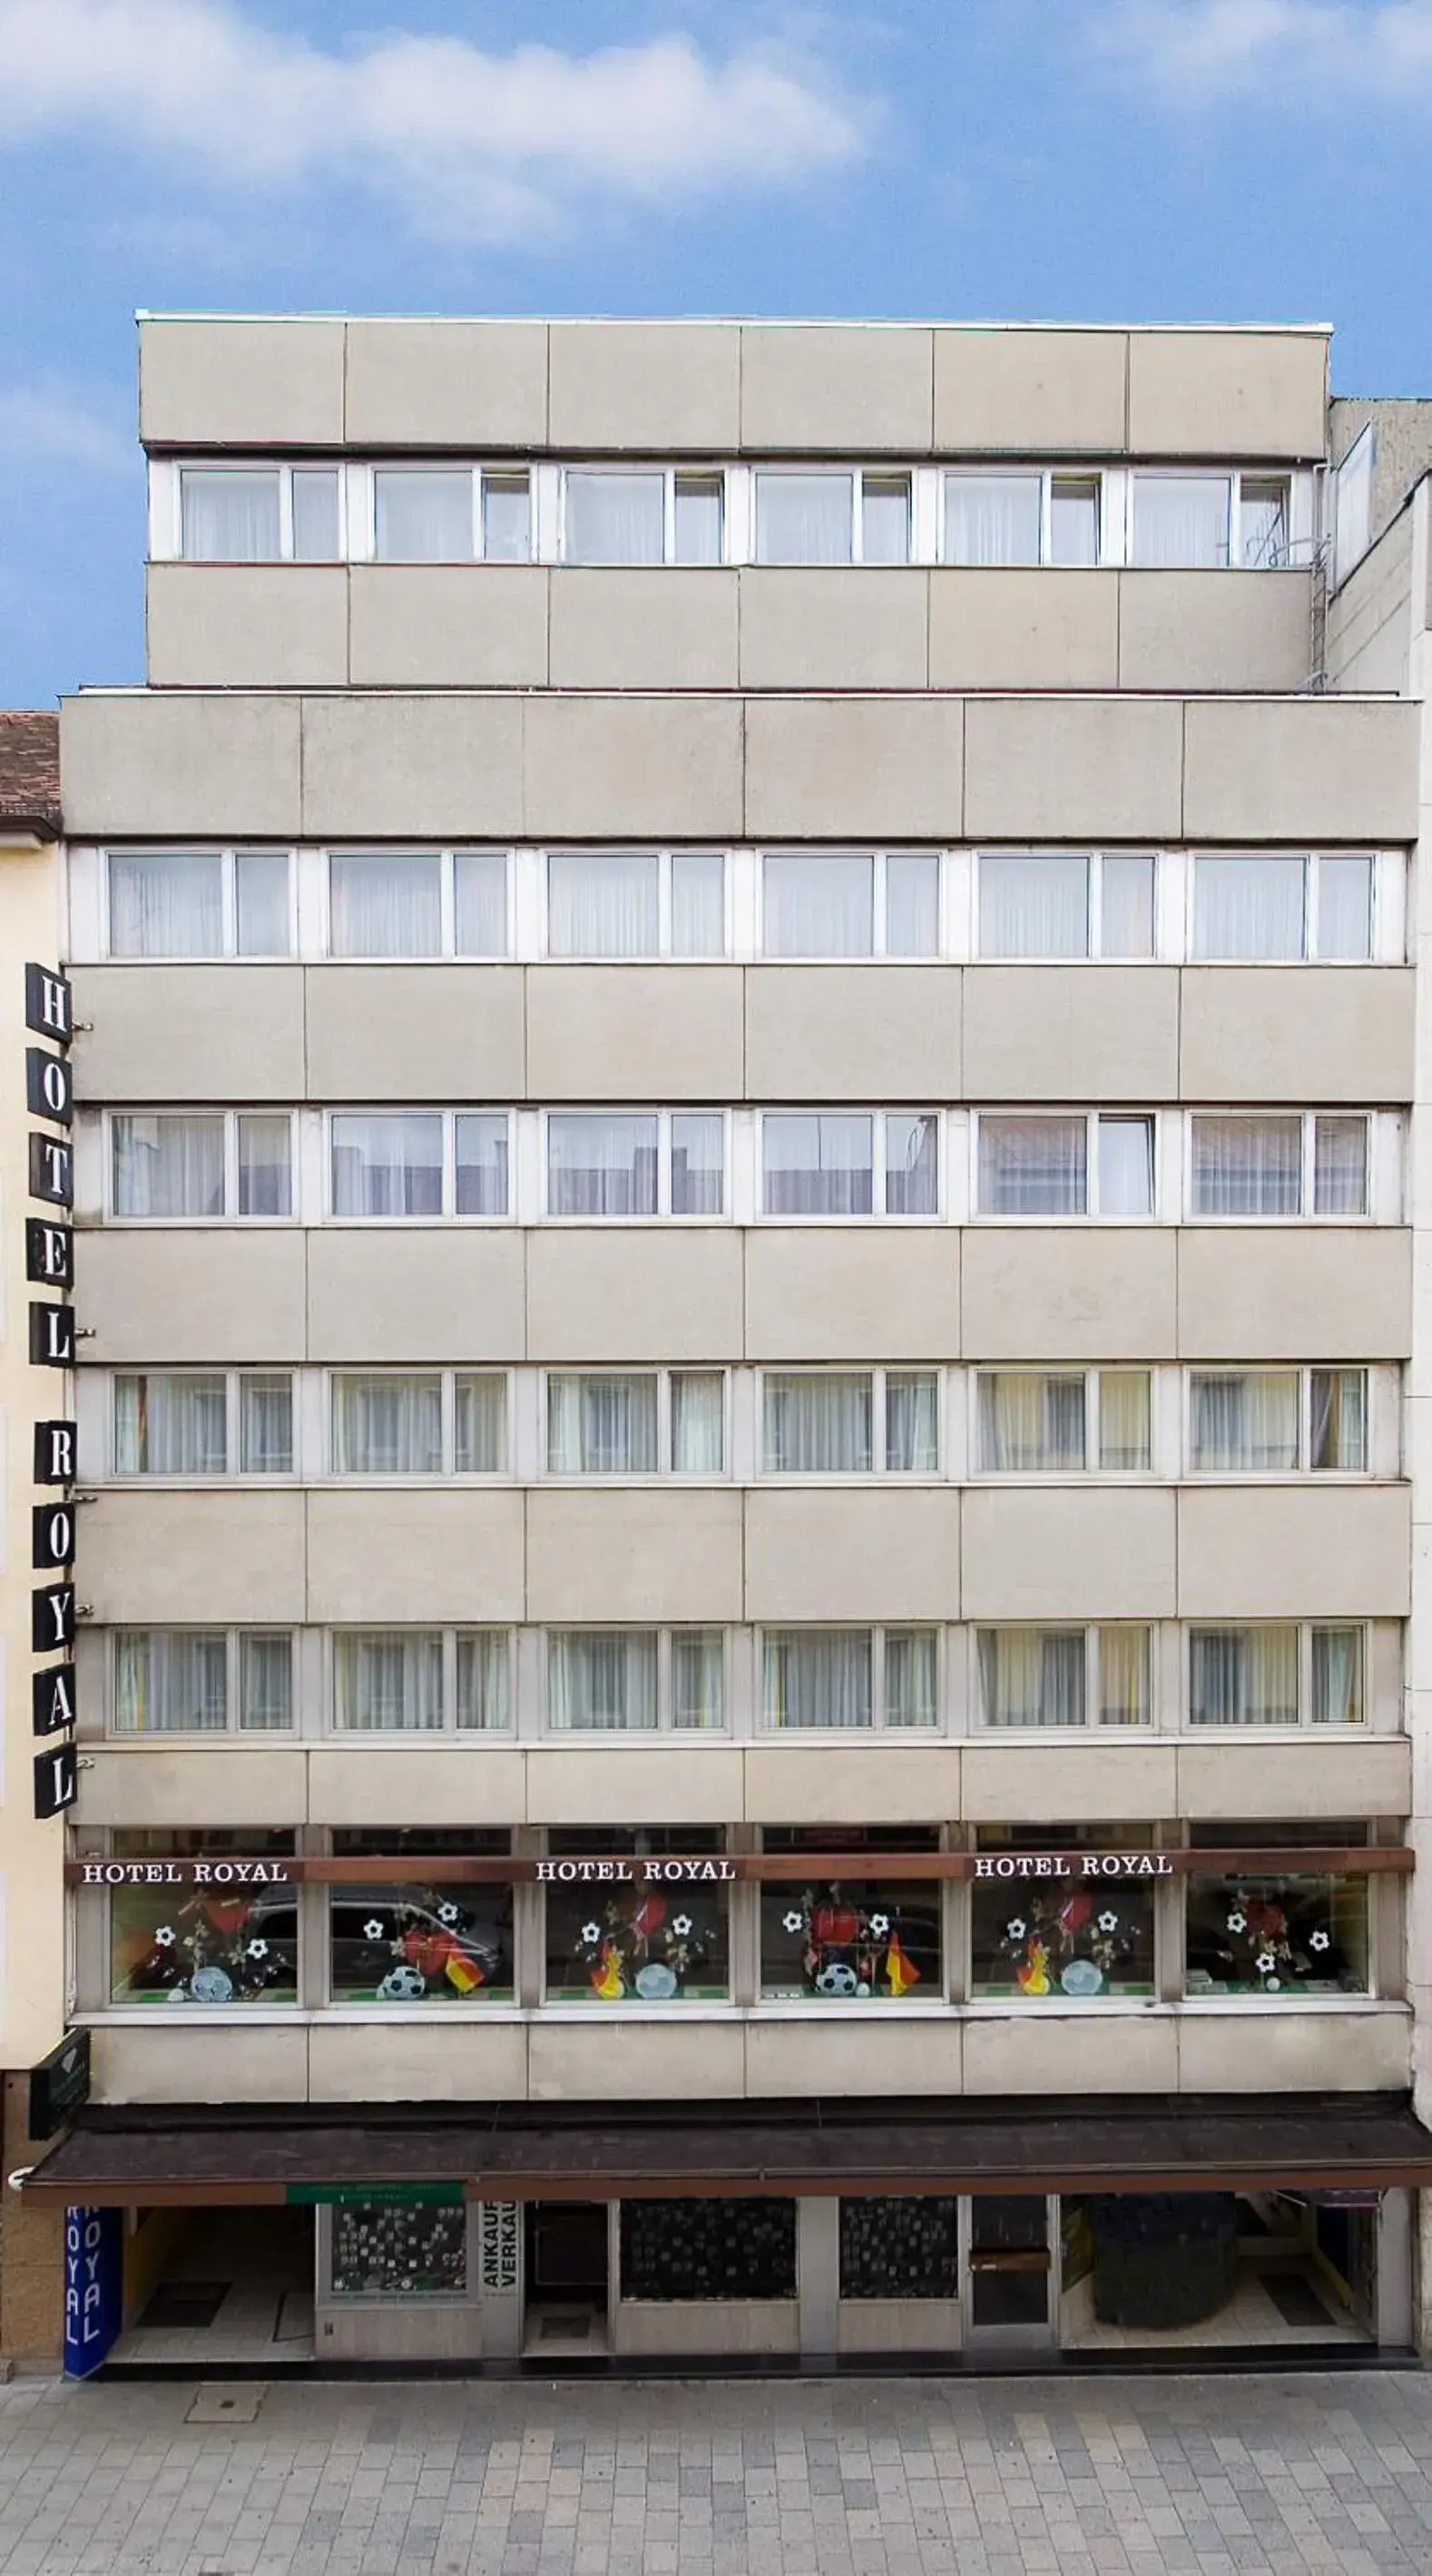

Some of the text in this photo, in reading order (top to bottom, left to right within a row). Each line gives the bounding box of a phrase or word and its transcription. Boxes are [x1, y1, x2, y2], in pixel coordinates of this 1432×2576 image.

[41, 975, 73, 1809] HOTEL ROYAL
[83, 1863, 288, 1883] HOTEL ROYAL
[535, 1861, 736, 1881] HOTEL ROYAL
[975, 1855, 1173, 1877] HOTEL ROYAL
[502, 2200, 516, 2287] VERKAU
